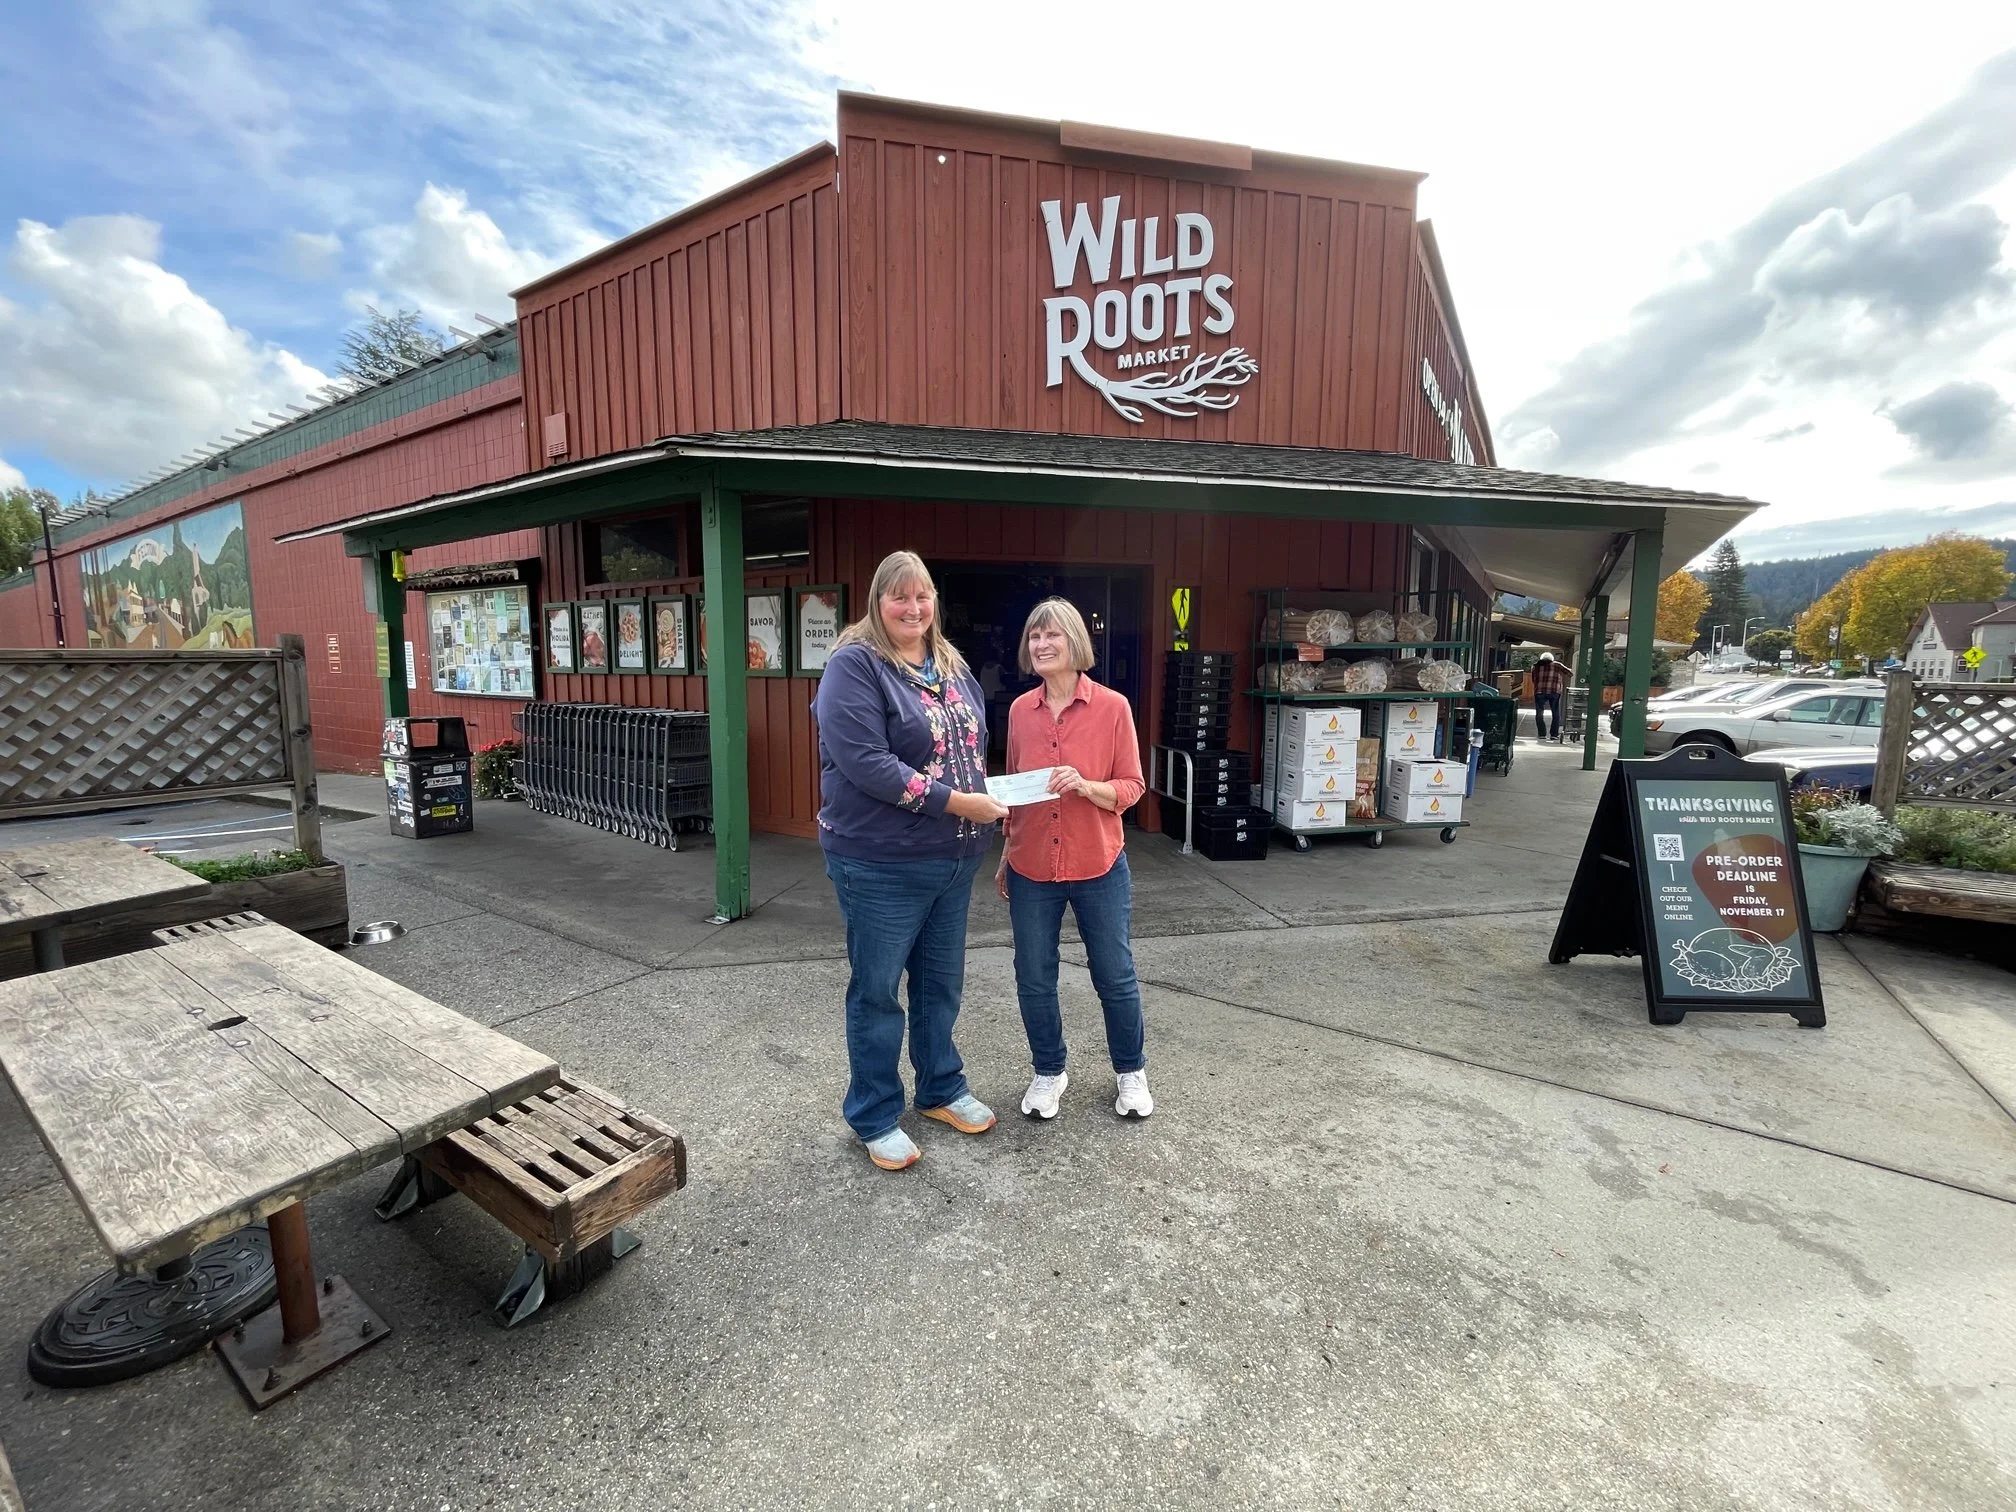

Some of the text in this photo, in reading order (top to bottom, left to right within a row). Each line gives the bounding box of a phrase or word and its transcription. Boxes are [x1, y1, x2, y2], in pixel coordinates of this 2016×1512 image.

[1041, 195, 1214, 289] WILD
[1043, 273, 1235, 388] ROOTS
[1117, 344, 1191, 370] MARKET
[750, 617, 774, 626] SAVOR
[676, 618, 684, 651] SHARE
[805, 629, 834, 638] ORDER
[812, 642, 827, 650] today
[1645, 797, 1775, 813] THANKSGIVING
[1679, 815, 1697, 823] with
[1706, 855, 1783, 867] PRE-ORDER
[1717, 871, 1777, 882] DEADLINE
[1745, 884, 1755, 893] IS
[1720, 907, 1785, 916] NOVEMBER 17
